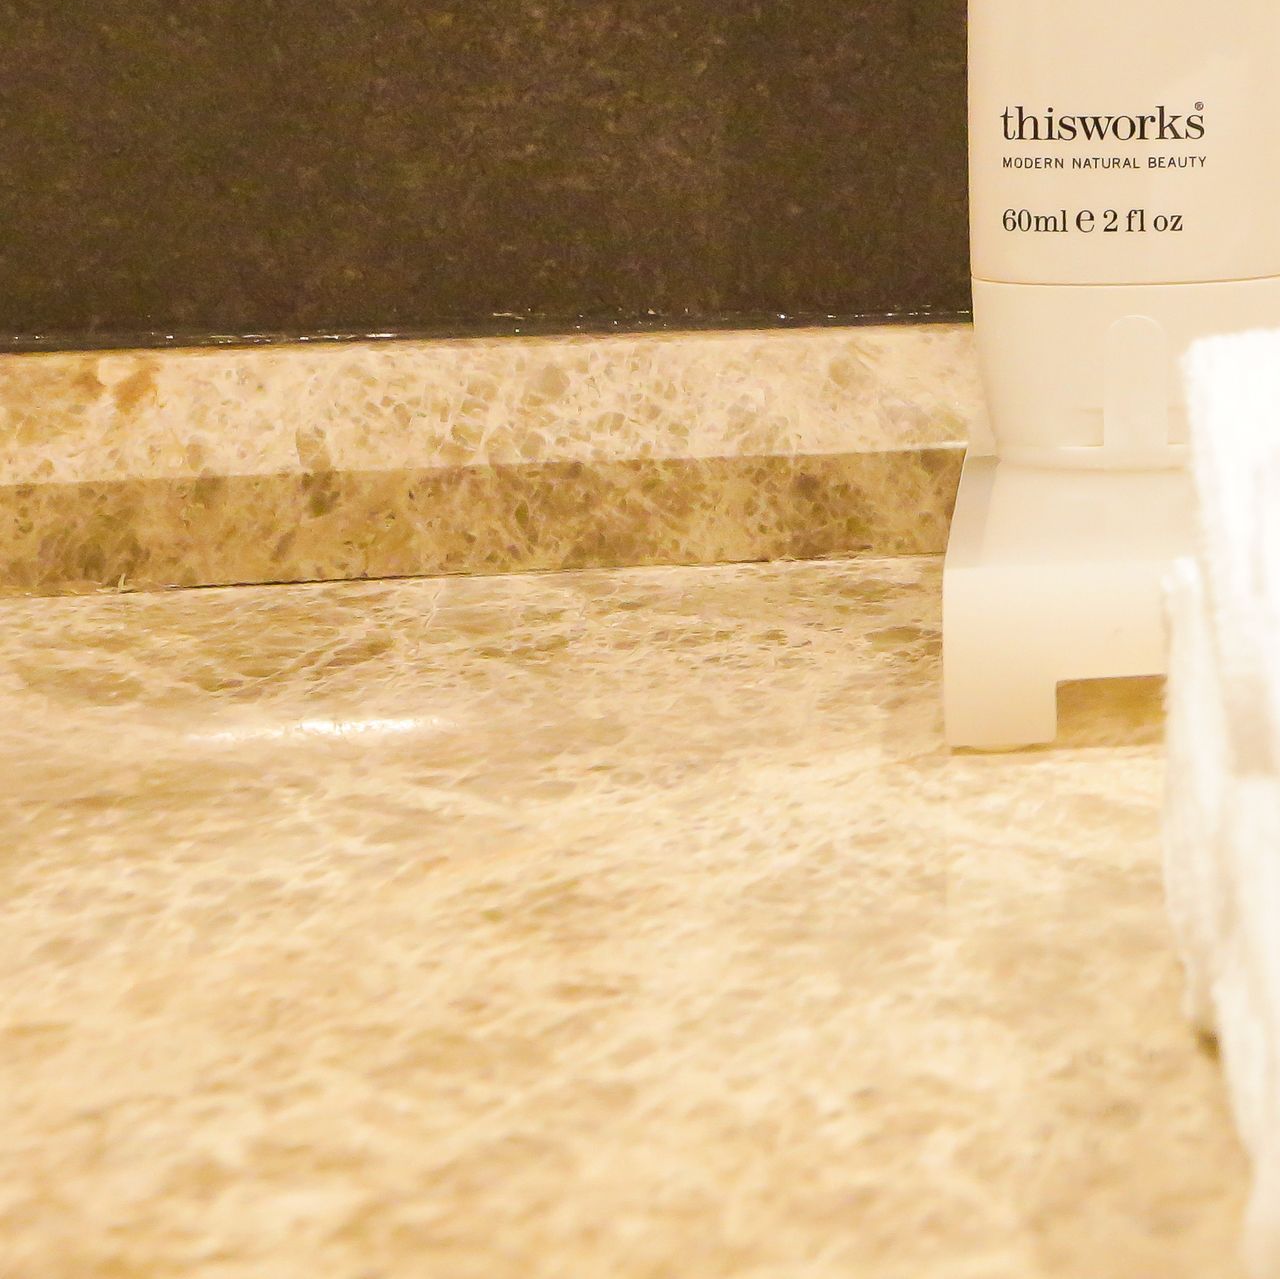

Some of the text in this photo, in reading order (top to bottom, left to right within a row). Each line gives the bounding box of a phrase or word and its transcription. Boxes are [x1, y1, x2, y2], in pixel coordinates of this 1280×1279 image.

[1002, 155, 1207, 170] MODERN NATURAL BEAUTY
[1001, 208, 1069, 234] 60ml
[1102, 209, 1119, 233] 2
[1125, 208, 1147, 233] fl
[1152, 214, 1183, 233] oz
